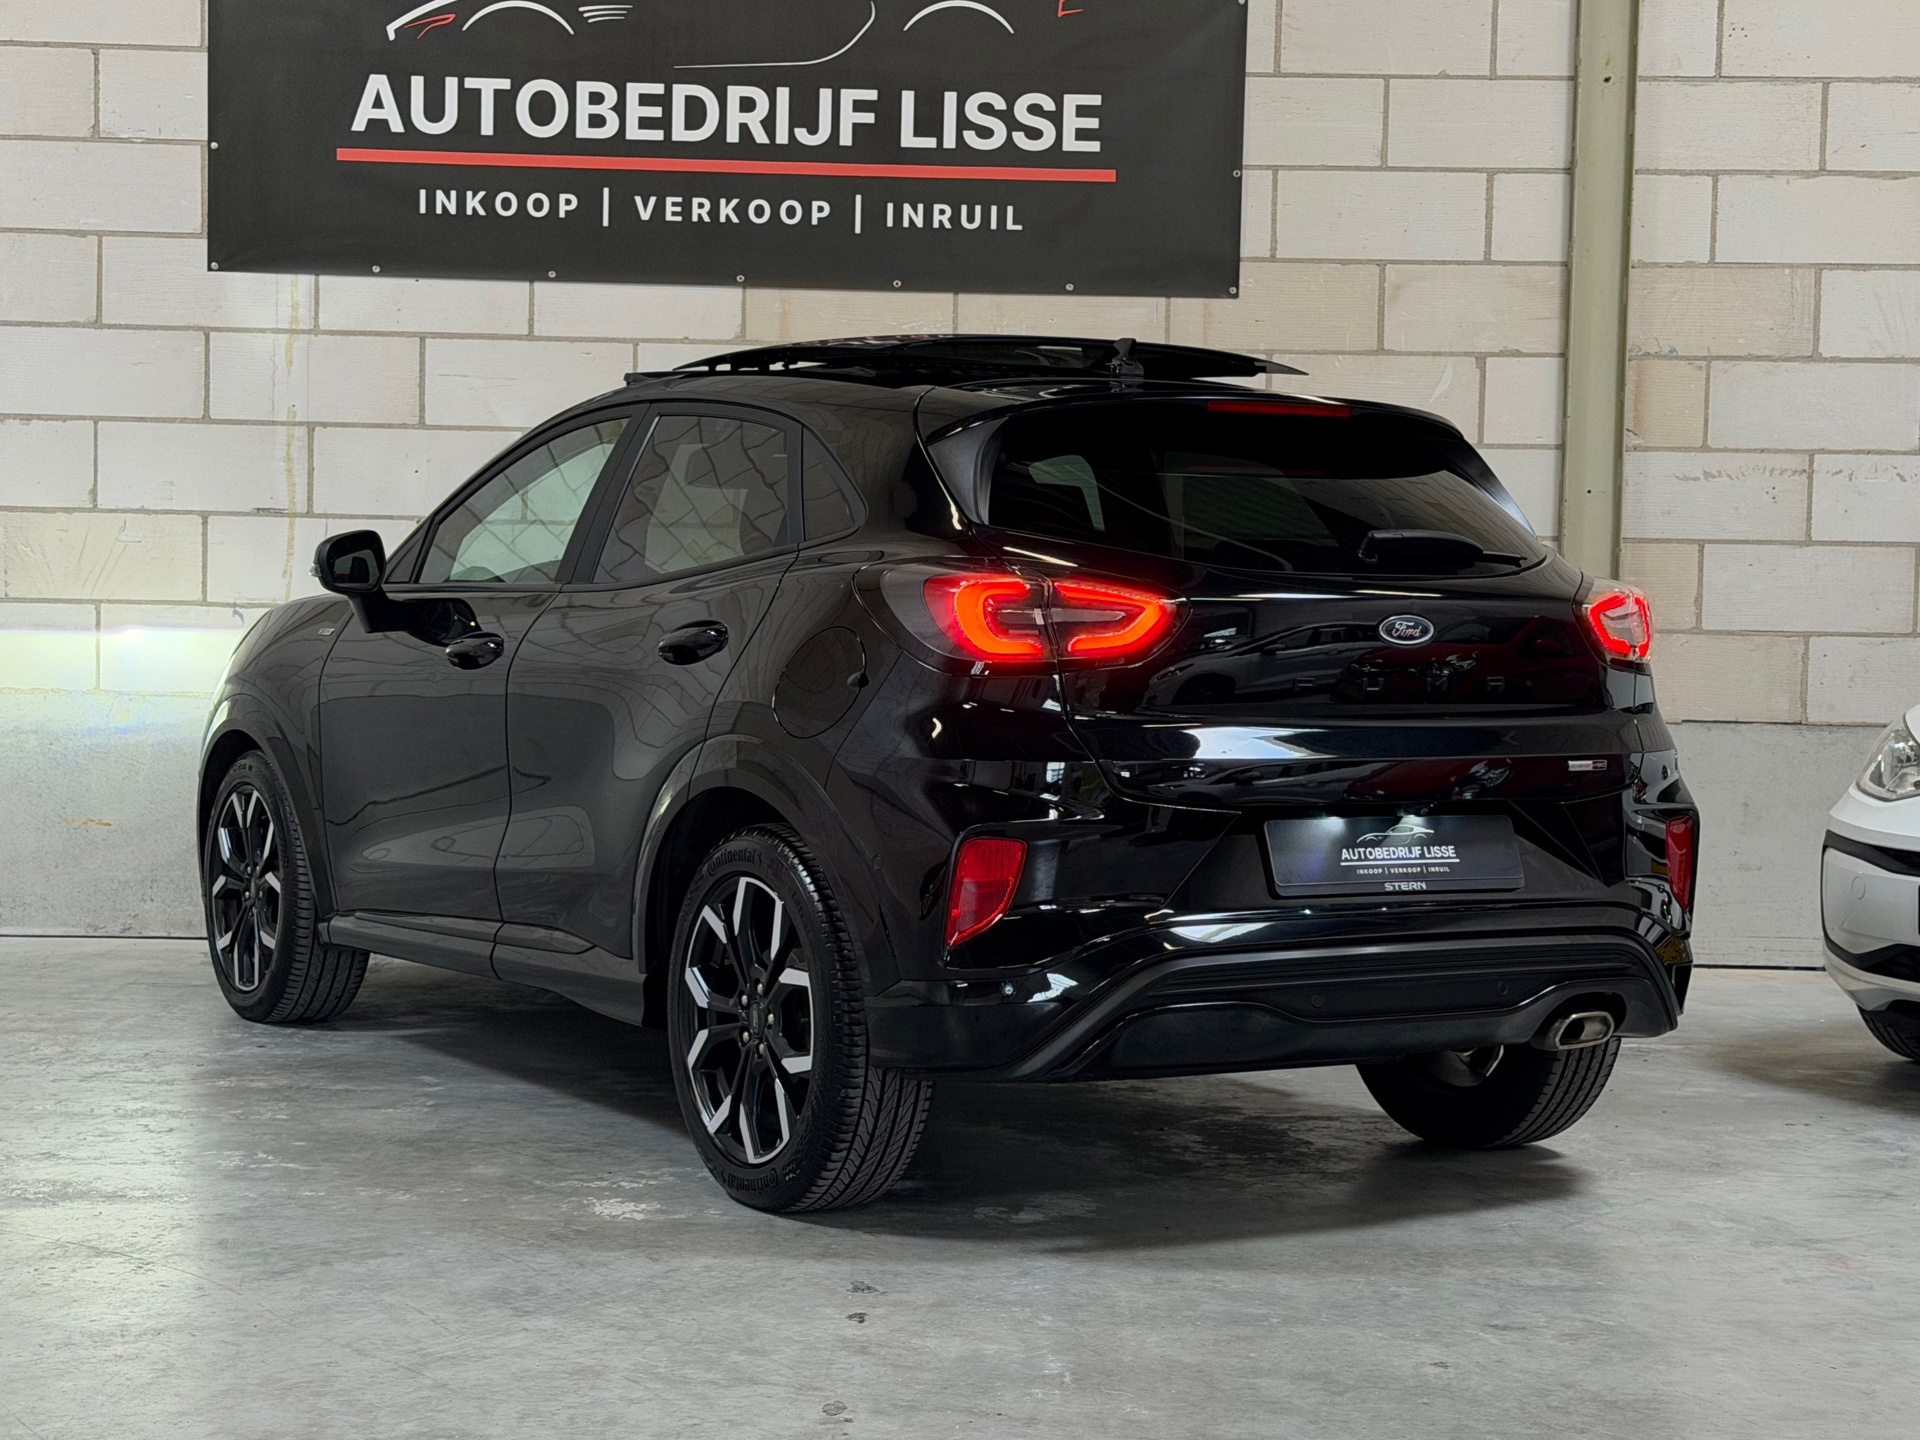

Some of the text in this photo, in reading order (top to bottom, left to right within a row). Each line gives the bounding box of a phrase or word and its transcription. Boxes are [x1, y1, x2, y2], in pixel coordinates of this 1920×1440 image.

[350, 73, 1103, 153] AUTOBEDRIJF LISSE
[419, 188, 1023, 231] INKOOP VERKOOP INRUIL
[1391, 621, 1423, 638] Ford
[707, 848, 757, 876] Continental
[1341, 845, 1457, 860] AUTOBEDRIJF LISSE
[1384, 881, 1427, 891] STERN
